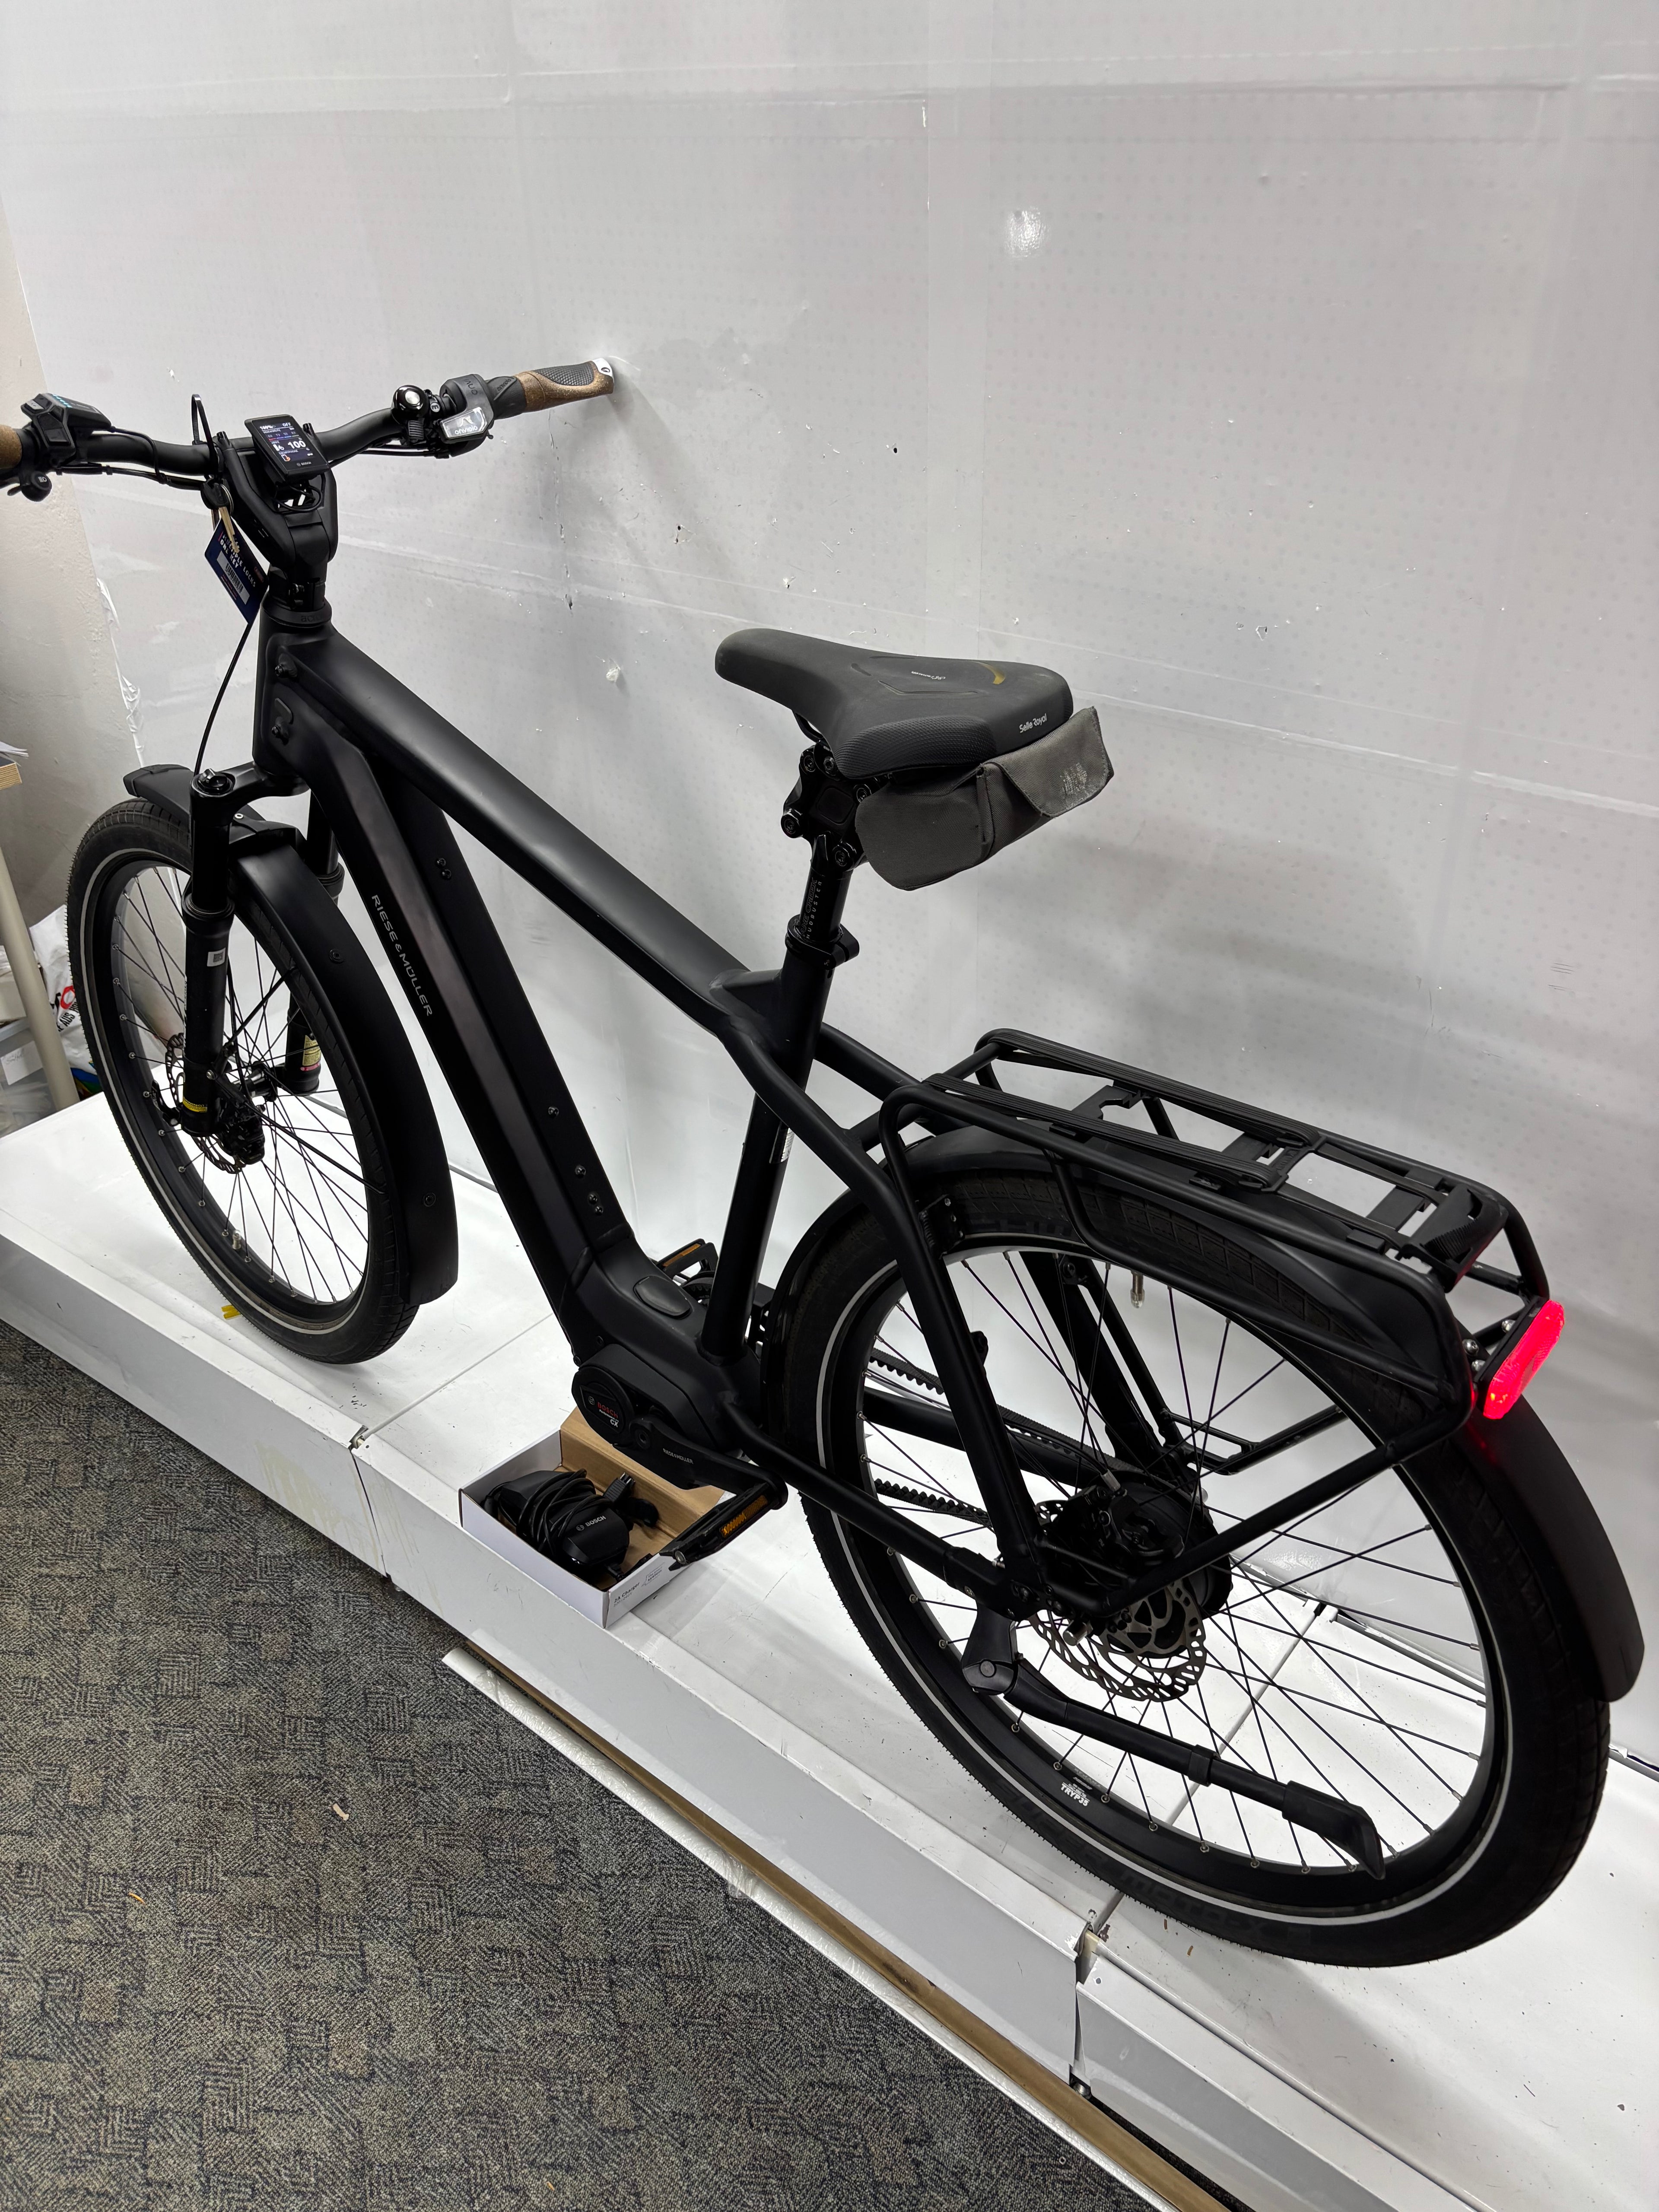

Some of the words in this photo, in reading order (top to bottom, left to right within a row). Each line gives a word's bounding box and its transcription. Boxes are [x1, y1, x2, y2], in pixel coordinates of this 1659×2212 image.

[288, 441, 306, 449] 100
[229, 555, 238, 568] KEY
[243, 566, 256, 587] LOCKS
[1019, 721, 1033, 733] Selle
[372, 894, 398, 942] RIESE
[399, 953, 432, 1016] MÜLLER
[59, 1012, 75, 1027] AUS
[597, 1402, 618, 1419] BOSCH
[610, 1419, 618, 1427] CX
[585, 1516, 606, 1527] BOSCH
[622, 1582, 640, 1597] Charger
[1061, 1783, 1089, 1806] TRYP35
